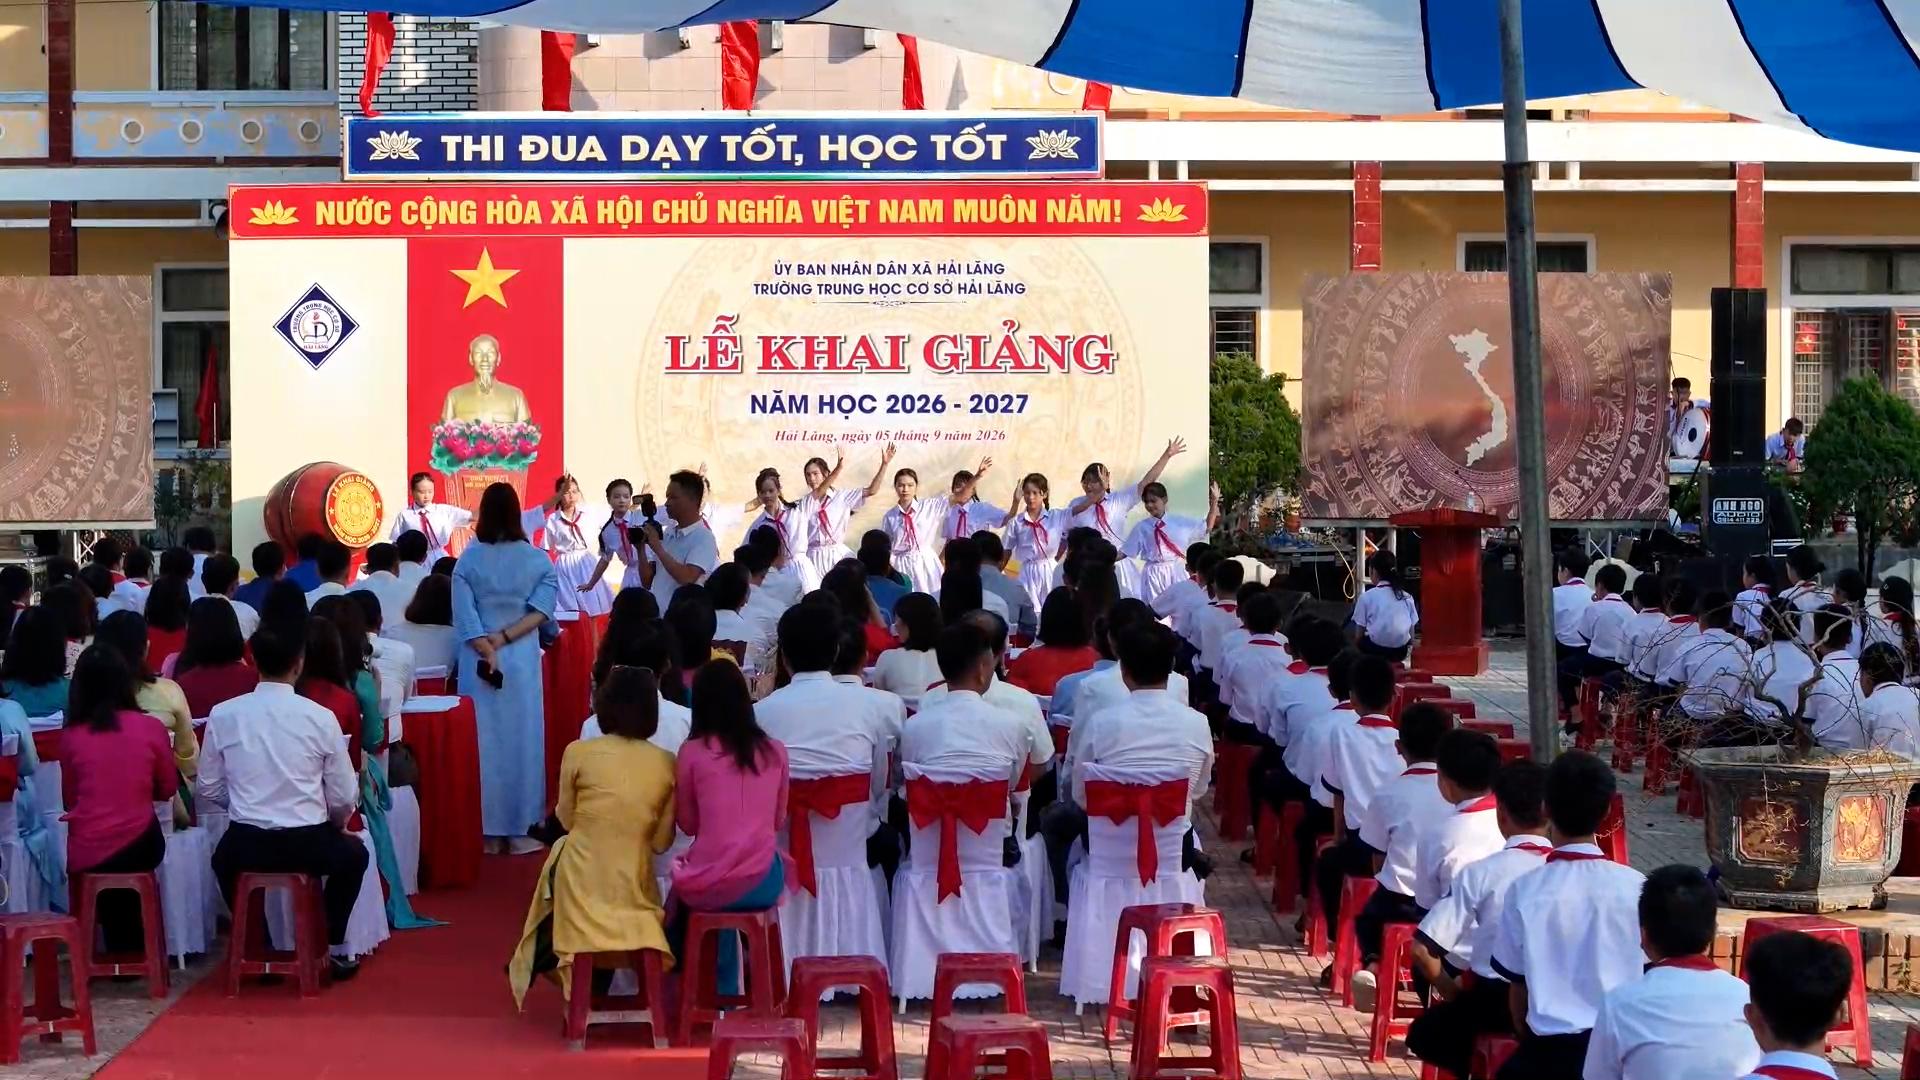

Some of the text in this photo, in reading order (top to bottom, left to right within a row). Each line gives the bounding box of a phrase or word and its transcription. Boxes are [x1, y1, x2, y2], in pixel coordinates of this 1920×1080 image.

[441, 122, 1007, 169] THI ĐUA DẠY TỐT, HỌC TỐT
[315, 191, 1121, 230] NƯỚC CỘNG HÒA XÃ HỘI CHỦ NGHĨA VIỆT NAM MUÔN NĂM!
[774, 258, 1005, 275] ỦY BAN NHÂN DÂN XÃ HẢI LĂNG
[754, 278, 1026, 298] TRƯỜNG TRUNG HỌC CƠ SỞ HẢI LĂNG
[664, 313, 1119, 374] LỄ KHAI GIẢNG
[750, 390, 809, 414] NĂM
[818, 394, 877, 420] HỌC
[886, 394, 947, 414] 2026
[969, 394, 1029, 414] 2027
[841, 430, 871, 444] ngày
[875, 430, 891, 441] 05
[894, 430, 929, 442] tháng
[934, 430, 941, 440] 9
[945, 431, 972, 441] năm
[975, 430, 1006, 441] 2026
